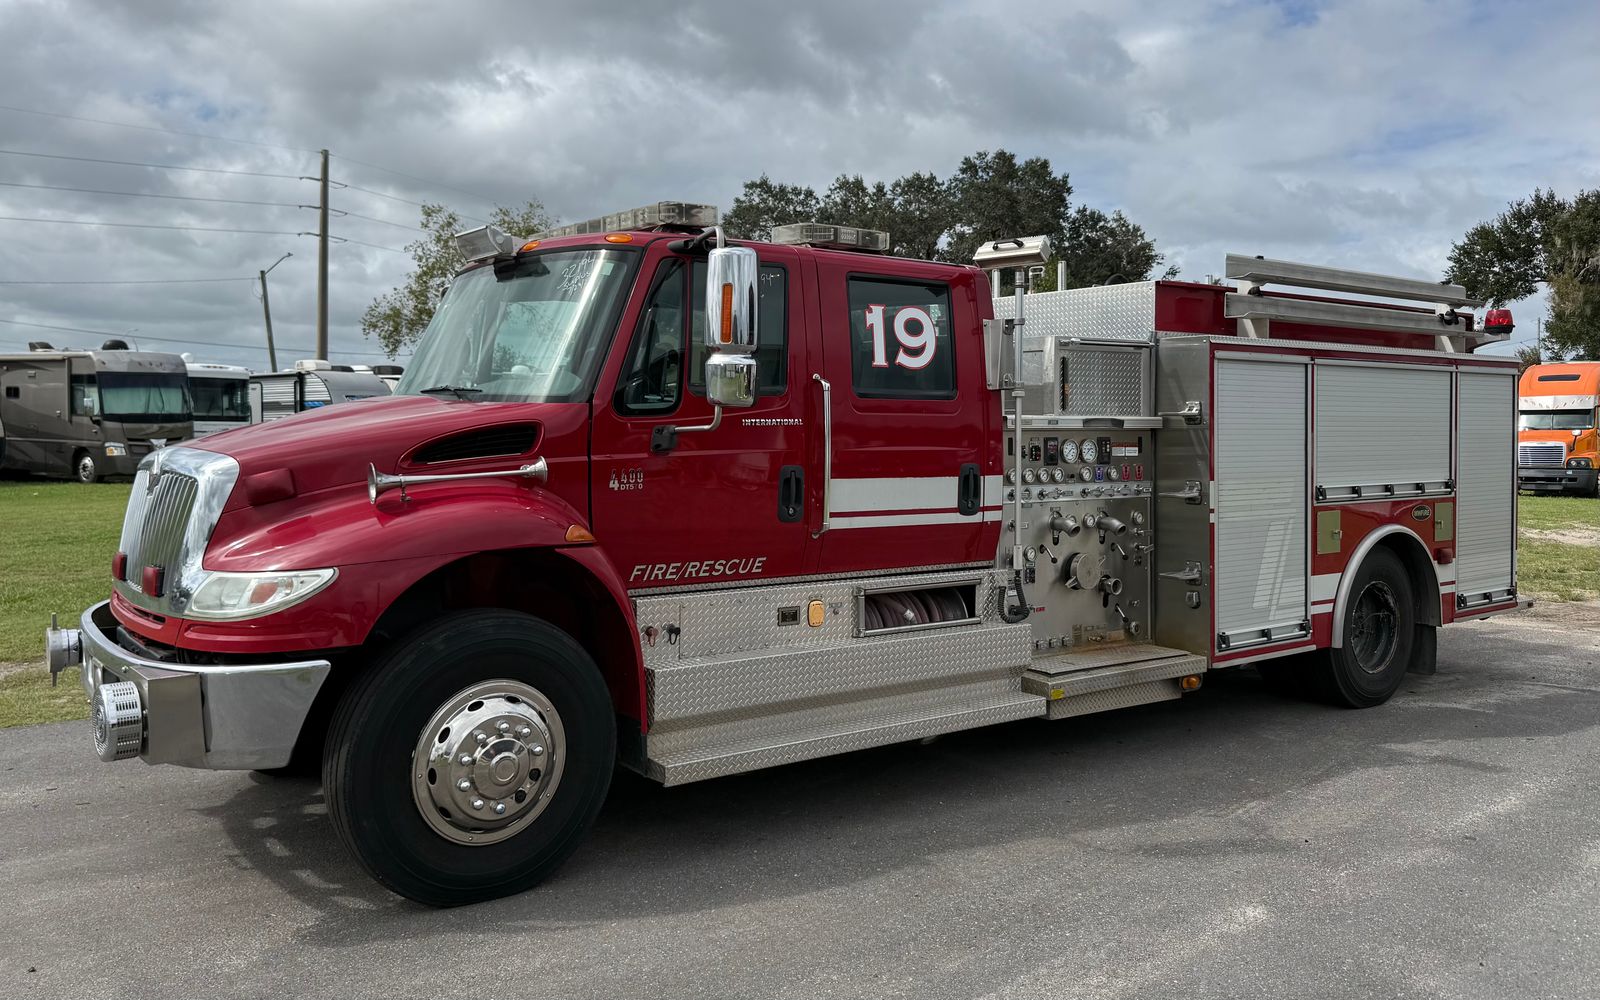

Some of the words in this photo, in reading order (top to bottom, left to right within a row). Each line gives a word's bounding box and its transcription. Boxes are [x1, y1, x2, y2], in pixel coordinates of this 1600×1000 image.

[864, 303, 938, 370] 19
[742, 418, 804, 427] INTERNATIONAL
[629, 557, 767, 582] FIRE/RESCUE
